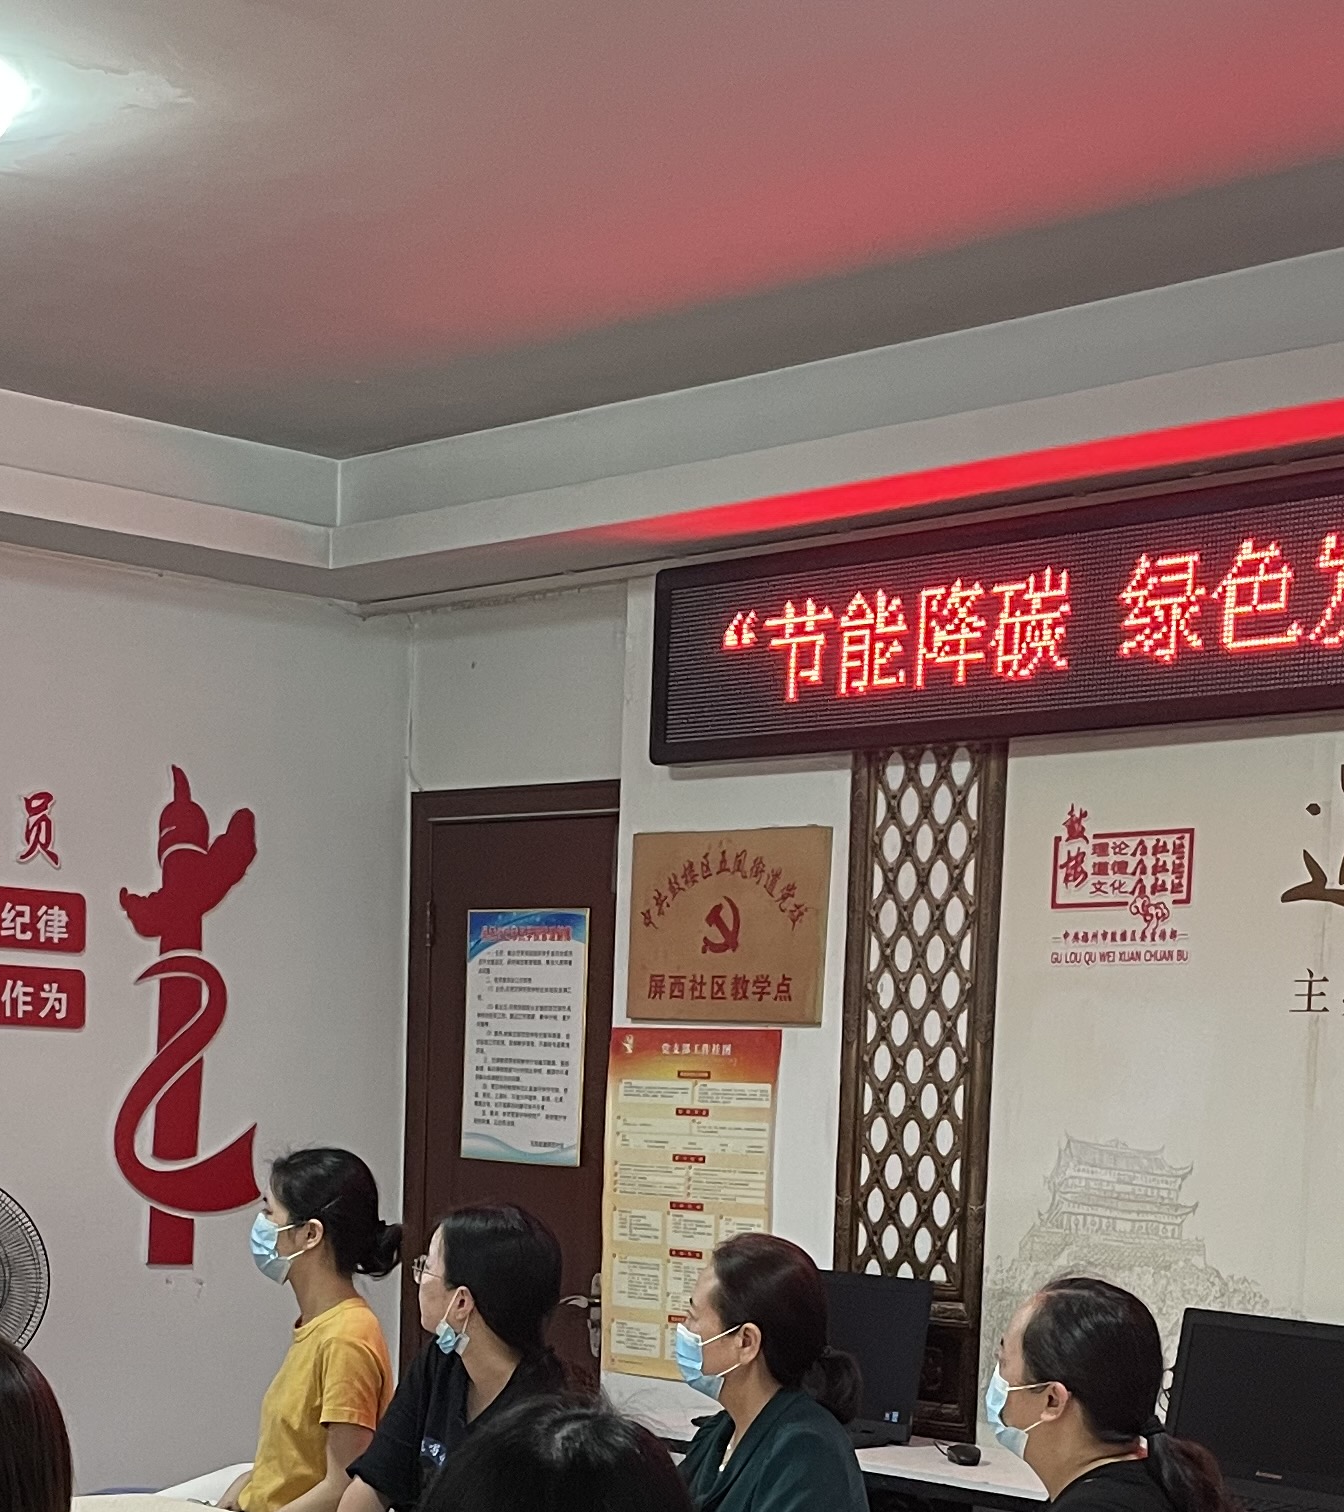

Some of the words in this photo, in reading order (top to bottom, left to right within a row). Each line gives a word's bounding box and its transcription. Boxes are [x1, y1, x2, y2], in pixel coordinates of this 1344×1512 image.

[1065, 951, 1081, 964] LOU
[1084, 951, 1096, 966] QU
[1099, 951, 1116, 963] WEI
[1119, 950, 1141, 963] XUAN
[1144, 950, 1173, 962] CHUAN
[1176, 949, 1188, 962] BU
[647, 973, 793, 1002] 屏西社区教学点
